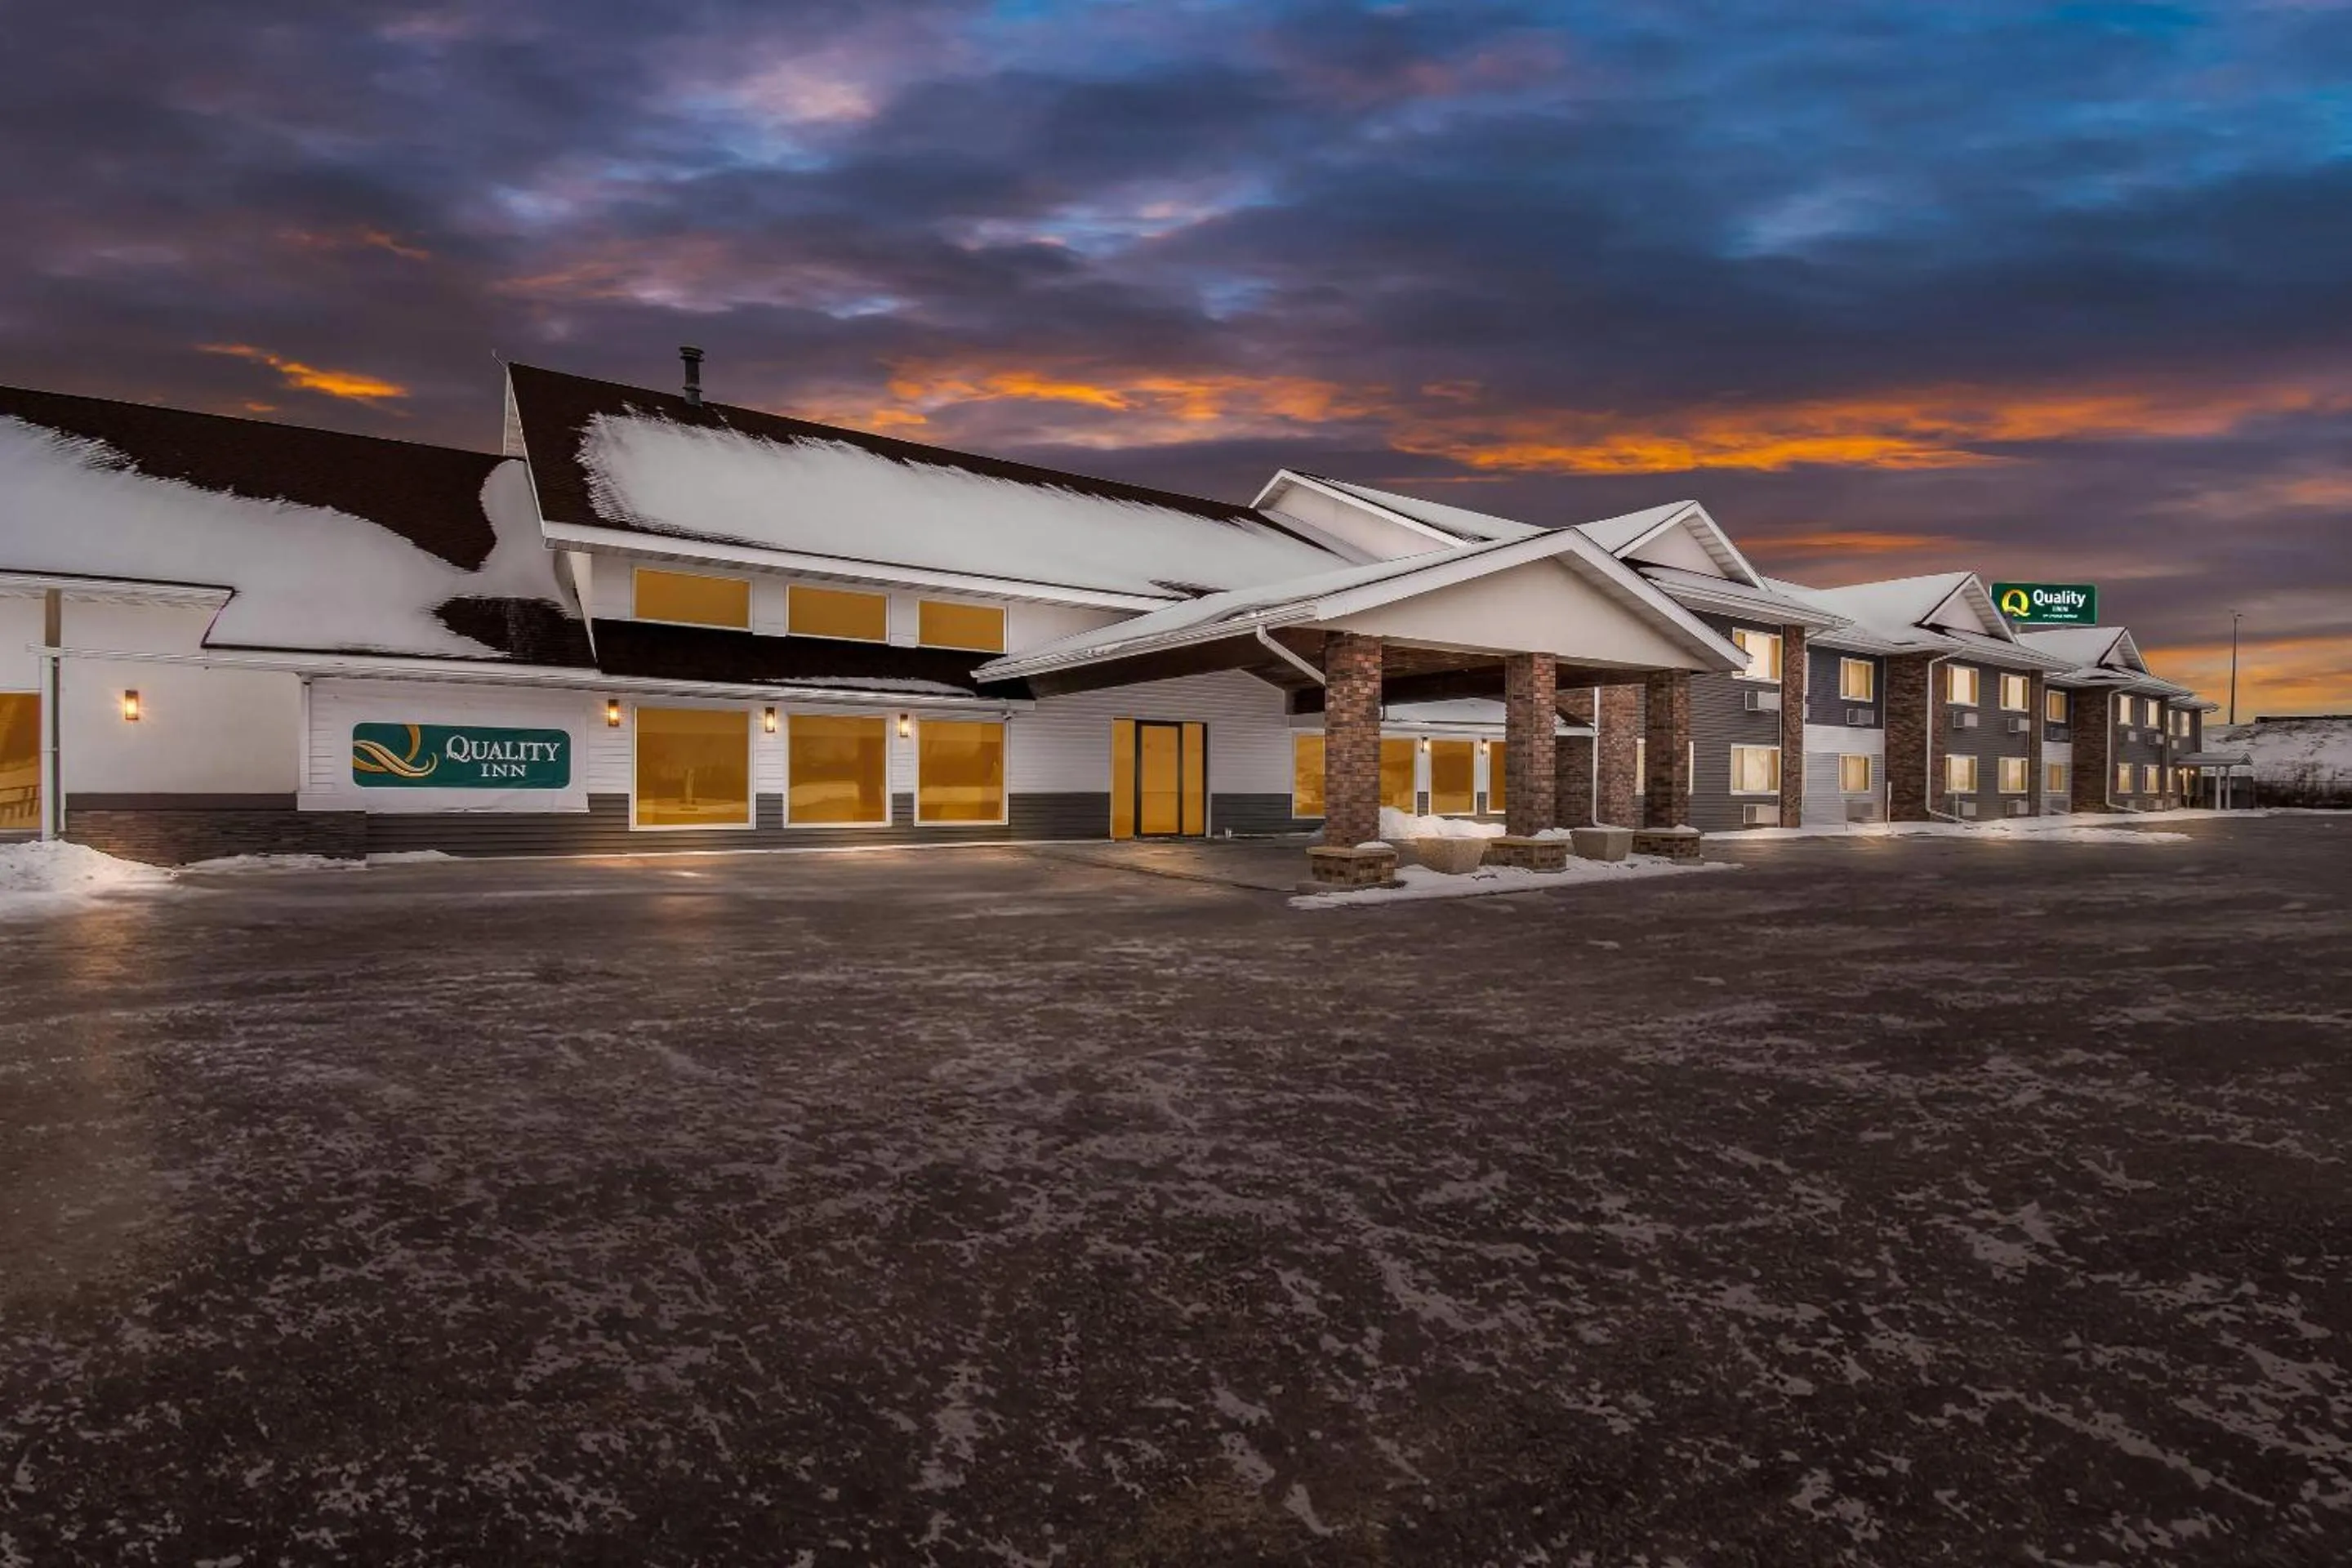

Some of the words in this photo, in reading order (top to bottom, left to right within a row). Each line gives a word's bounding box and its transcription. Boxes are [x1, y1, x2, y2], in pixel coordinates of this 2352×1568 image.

[2002, 589, 2030, 617] Q
[2033, 589, 2086, 608] Quality
[446, 735, 560, 763] QUALITY
[480, 764, 527, 777] INN
